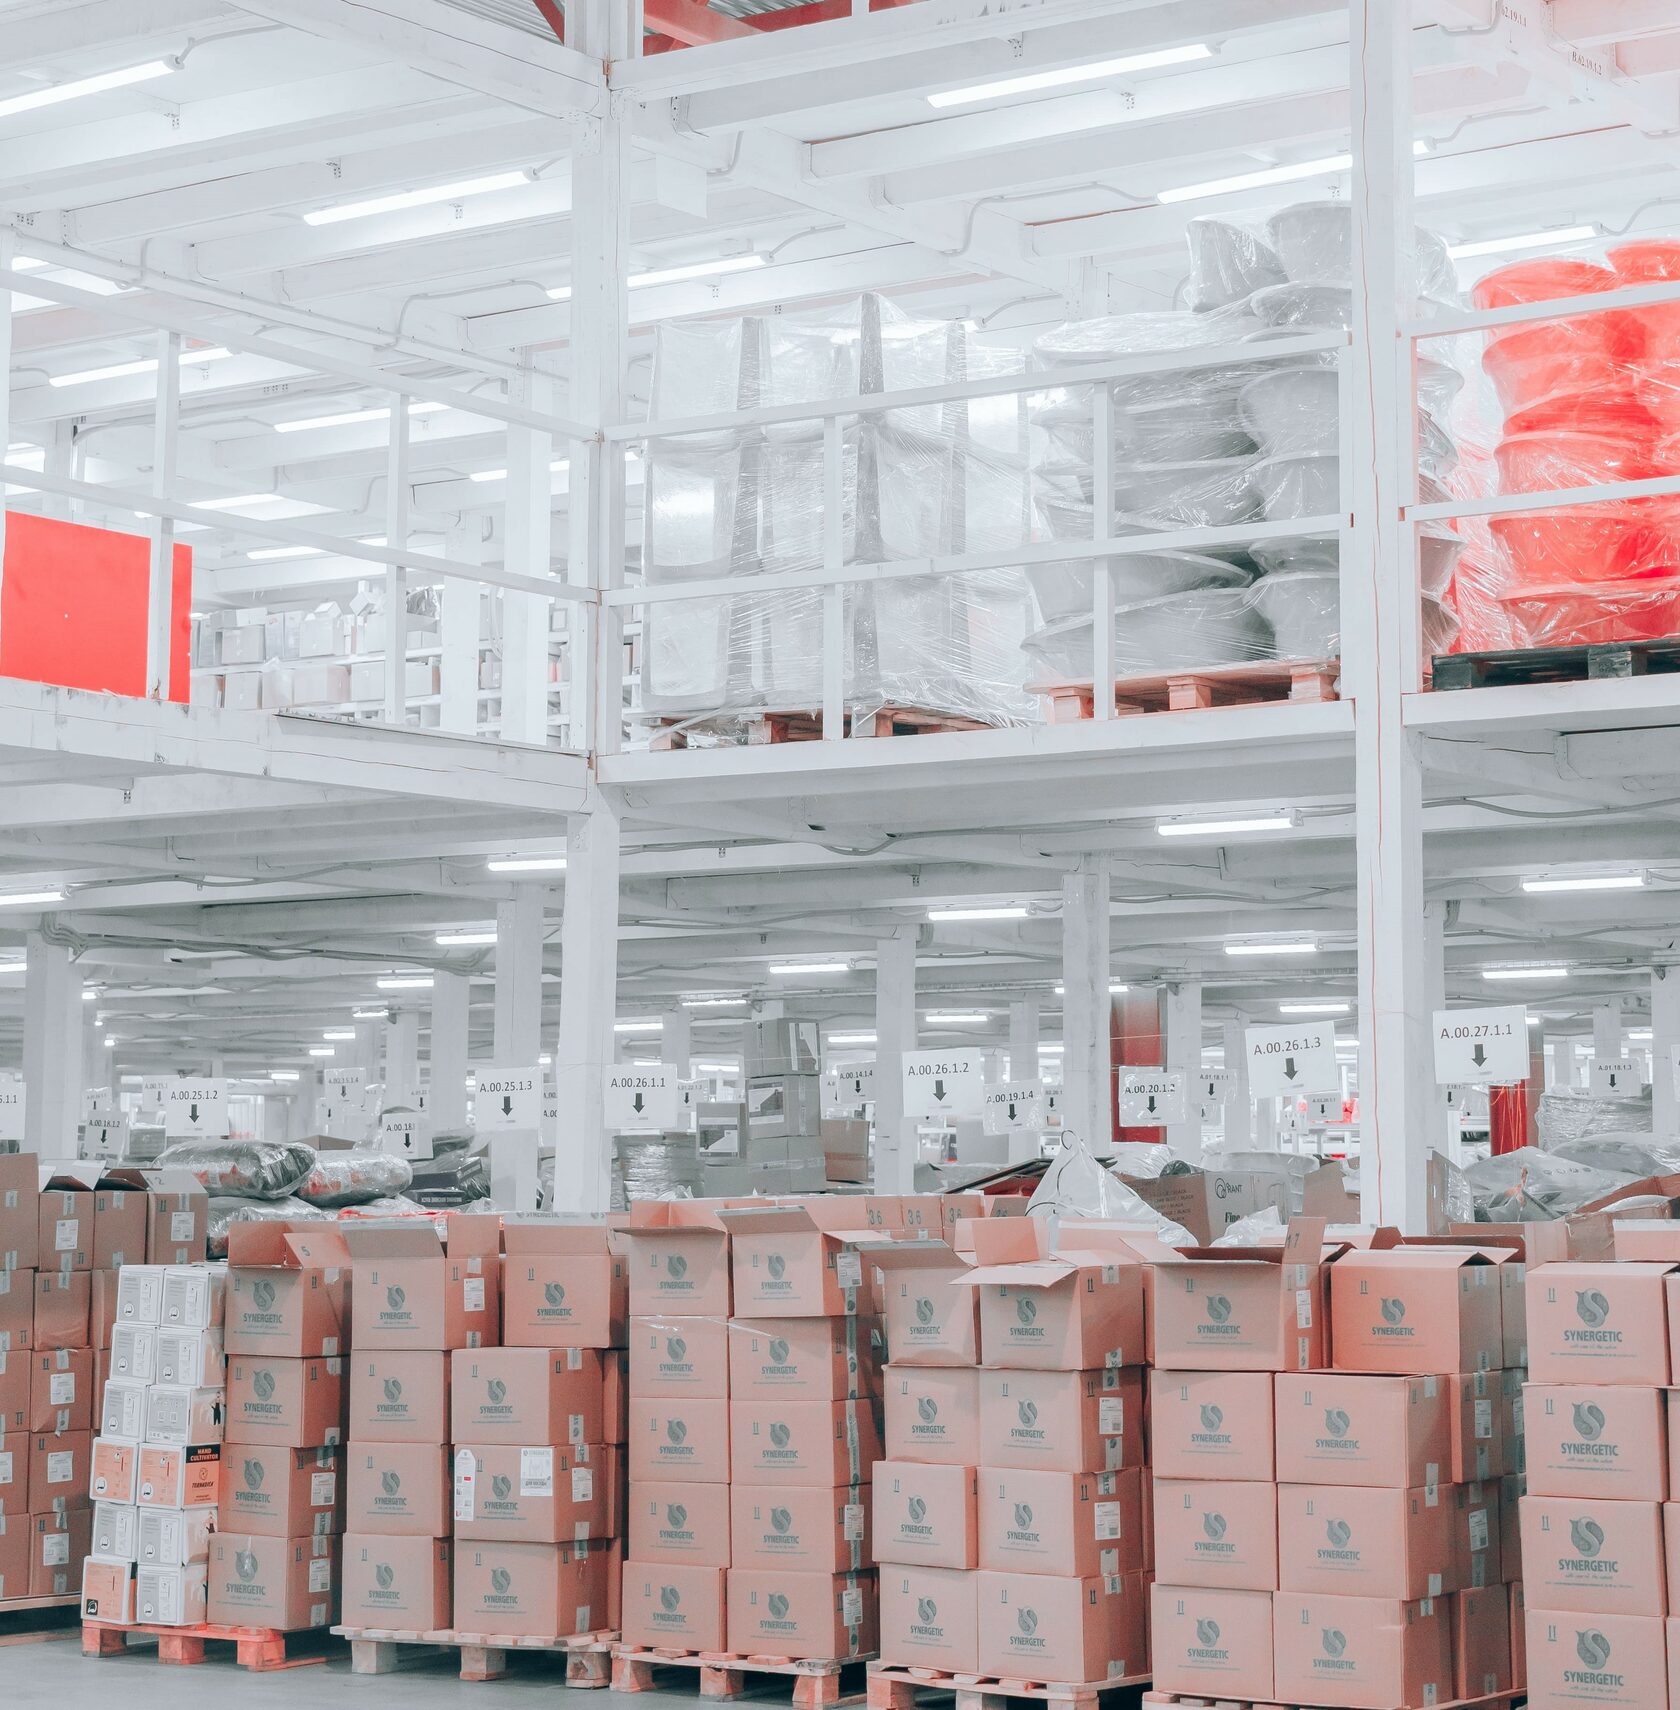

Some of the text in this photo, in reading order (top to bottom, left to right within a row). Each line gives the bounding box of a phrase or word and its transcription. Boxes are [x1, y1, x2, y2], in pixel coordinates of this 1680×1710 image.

[1440, 1023, 1512, 1040] A.00.27.1.1
[1253, 1036, 1321, 1056] A.00.26.1.3
[908, 1062, 969, 1077] A.00.26.1.2
[479, 1080, 533, 1093] A.00.25.1.3
[610, 1077, 666, 1088] A.00.26.1.1
[1124, 1083, 1176, 1095] A.00.20.1.2
[170, 1090, 218, 1101] A.00.25.1.2
[986, 1090, 1034, 1104] A.00.19.1.4
[660, 1281, 694, 1289] SYNERGETIC
[761, 1281, 792, 1289] SYNERGETIC
[380, 1312, 412, 1320] SYNERGETIC
[537, 1308, 571, 1316] SYNERGETIC
[243, 1313, 282, 1323] SYNERGETIC
[910, 1326, 940, 1334] SYNERGETIC
[1010, 1328, 1044, 1336] SYNERGETIC
[1198, 1325, 1240, 1334] SYNERGETIC
[1372, 1327, 1414, 1336] SYNERGETIC
[1564, 1330, 1622, 1342] SYNERGETIC
[659, 1364, 693, 1372] SYNERGETIC
[762, 1366, 797, 1374] SYNERGETIC
[244, 1403, 282, 1414] SYNERGETIC
[377, 1404, 408, 1412] SYNERGETIC
[480, 1406, 512, 1414] SYNERGETIC
[912, 1425, 945, 1433] SYNERGETIC
[1011, 1429, 1044, 1439] SYNERGETIC
[1192, 1434, 1231, 1443] SYNERGETIC
[1316, 1439, 1359, 1449] SYNERGETIC
[660, 1446, 694, 1455] SYNERGETIC
[762, 1450, 798, 1458] SYNERGETIC
[1561, 1443, 1618, 1456] SYNERGETIC
[236, 1491, 270, 1503] SYNERGETIC
[375, 1497, 406, 1505] SYNERGETIC
[484, 1501, 518, 1510] SYNERGETIC
[901, 1524, 932, 1535] SYNERGETIC
[660, 1530, 694, 1540] SYNERGETIC
[764, 1535, 799, 1544] SYNERGETIC
[1007, 1531, 1039, 1542] SYNERGETIC
[1195, 1542, 1235, 1552] SYNERGETIC
[1318, 1550, 1360, 1560] SYNERGETIC
[1559, 1559, 1618, 1572] SYNERGETIC
[226, 1583, 265, 1595] SYNERGETIC
[369, 1591, 400, 1599] SYNERGETIC
[484, 1595, 518, 1604] SYNERGETIC
[653, 1613, 686, 1623] SYNERGETIC
[760, 1620, 797, 1630] SYNERGETIC
[911, 1626, 943, 1636] SYNERGETIC
[1010, 1636, 1045, 1647] SYNERGETIC
[1188, 1648, 1228, 1659] SYNERGETIC
[1313, 1659, 1355, 1669] SYNERGETIC
[1564, 1671, 1623, 1686] SYNERGETIC
